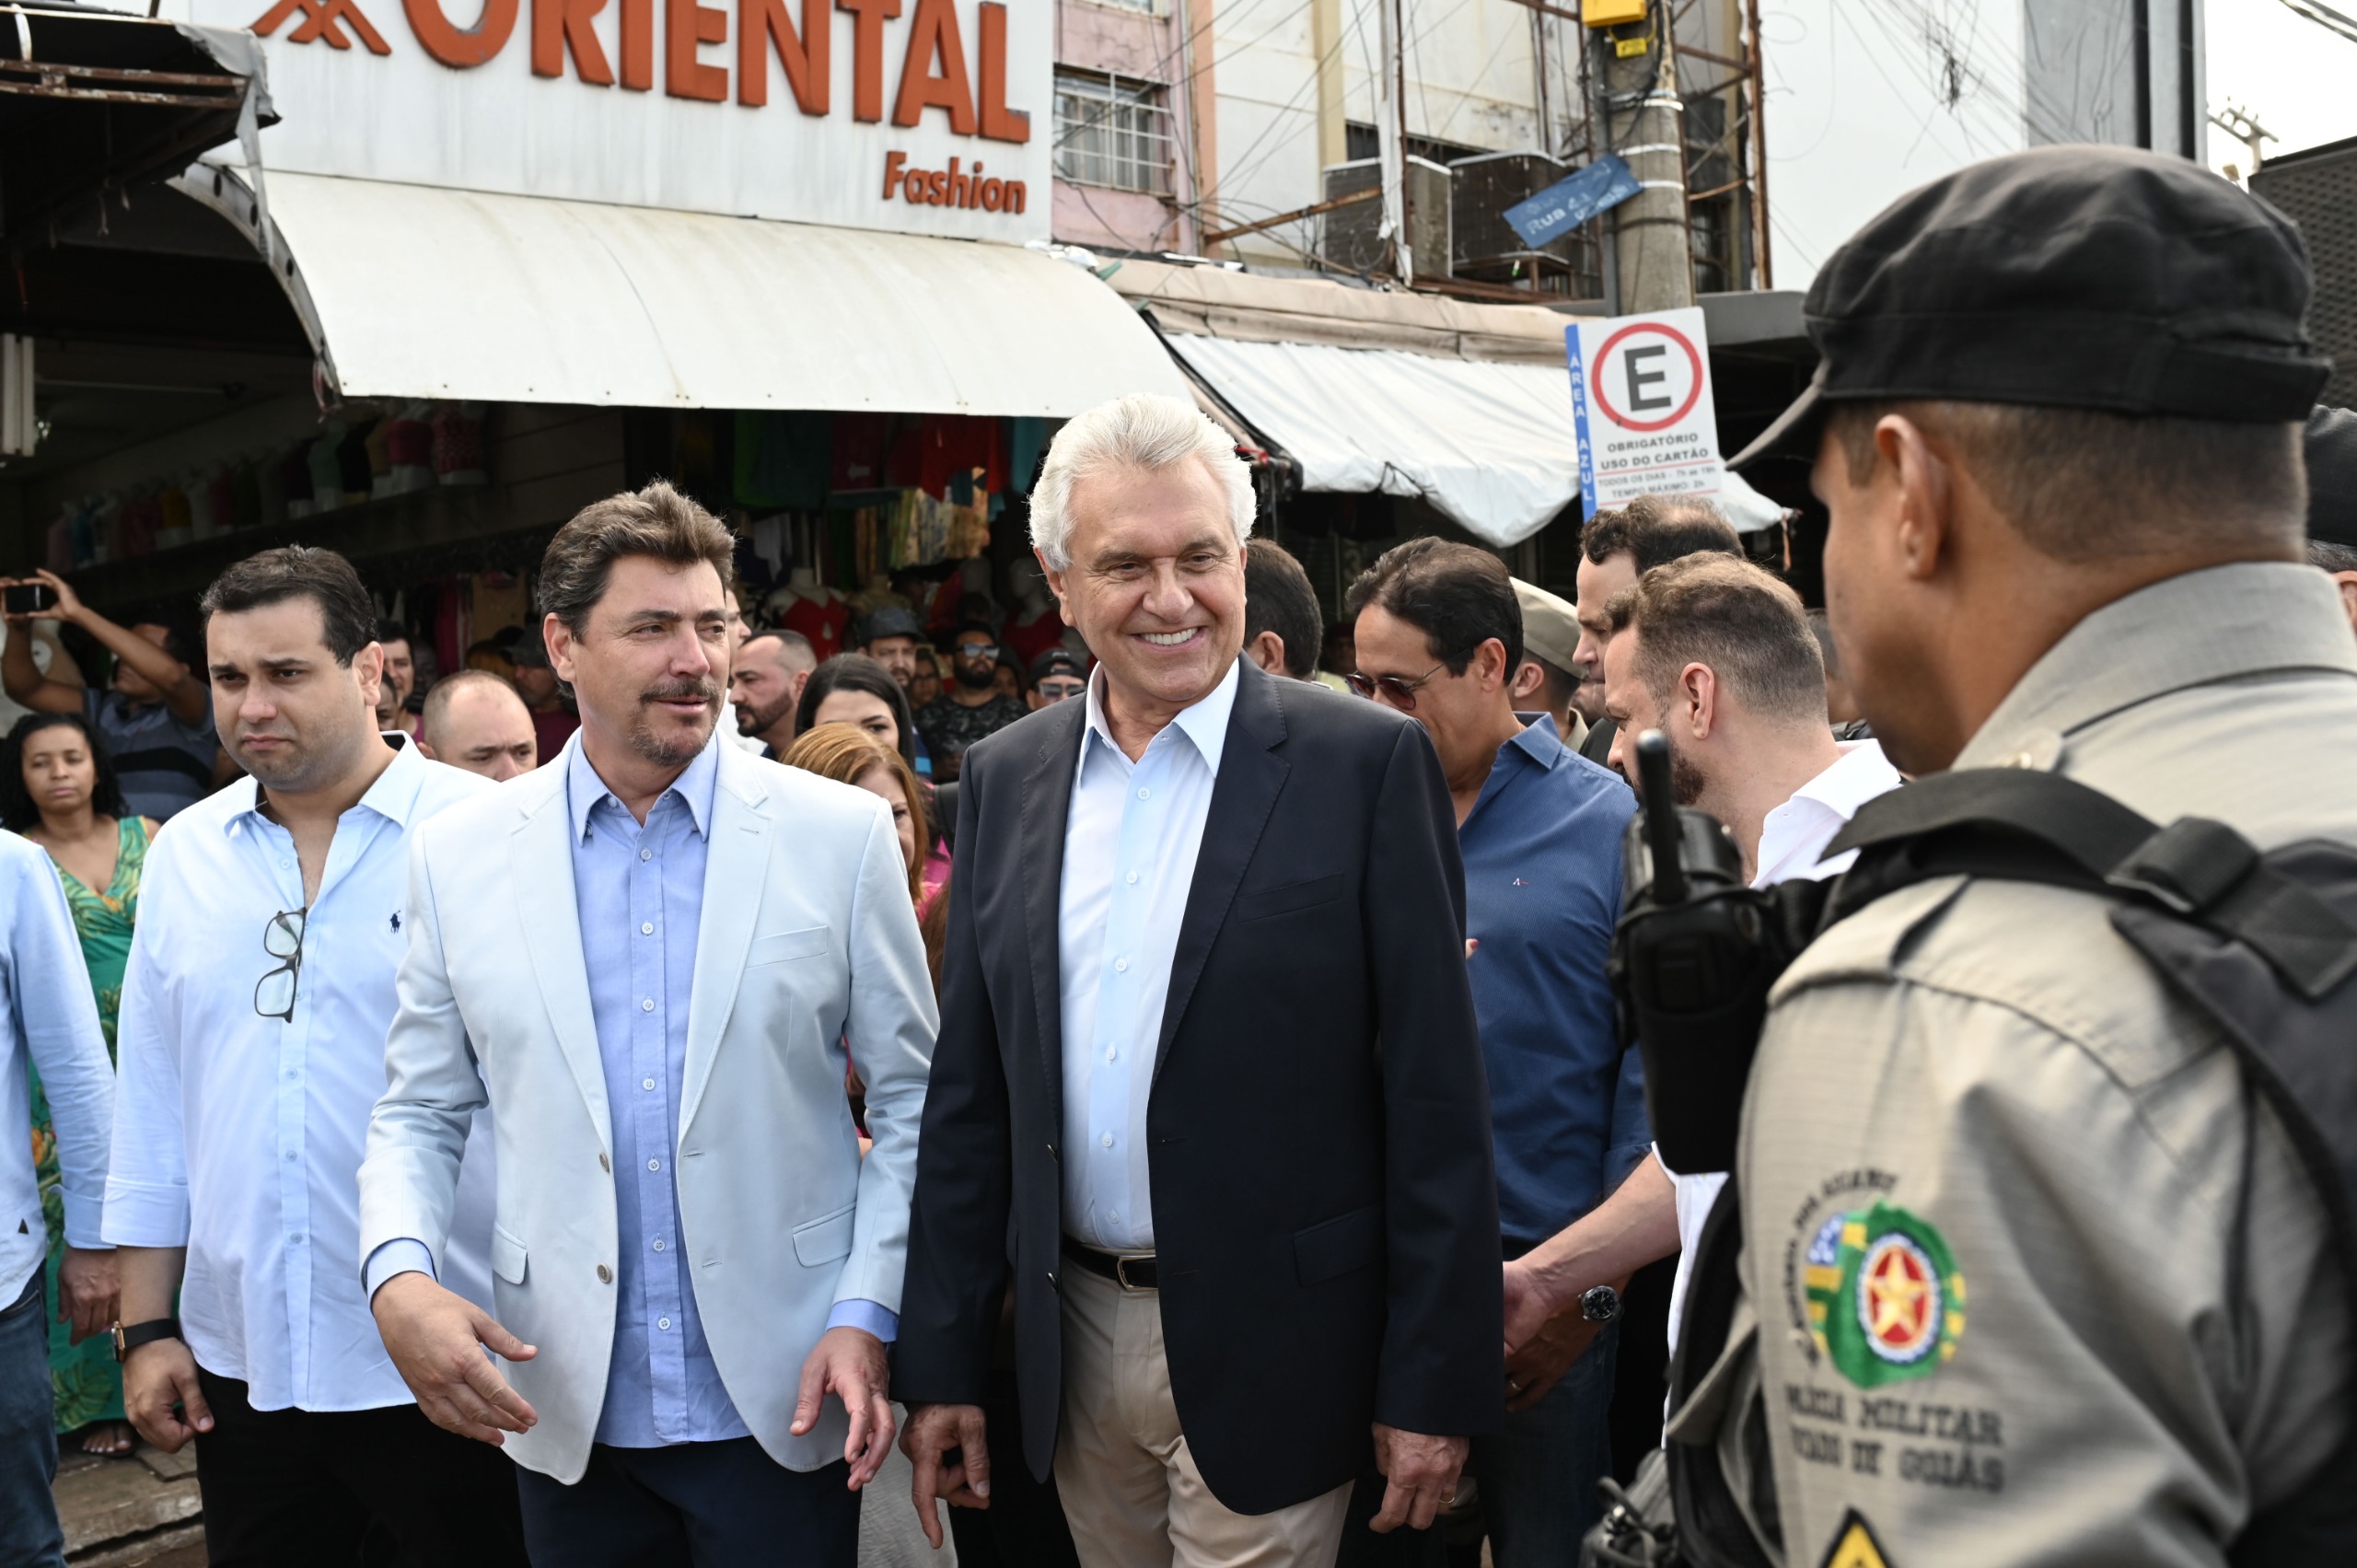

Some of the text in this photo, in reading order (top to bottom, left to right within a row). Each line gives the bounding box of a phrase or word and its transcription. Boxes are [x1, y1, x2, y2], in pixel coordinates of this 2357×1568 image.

[401, 0, 1030, 144] ORIENTAL
[883, 150, 1027, 215] Fashion
[1526, 207, 1566, 235] Rua
[1623, 343, 1672, 412] E
[1600, 447, 1709, 470] USO DO CARTÃO
[1607, 433, 1699, 453] OBRIGATÓRIO
[1578, 437, 1593, 502] AZUL
[1597, 475, 1629, 488] TODOS
[1631, 472, 1643, 483] OS
[1645, 470, 1666, 482] DIAS
[1612, 486, 1646, 499] TEMPO
[1859, 1397, 2003, 1446] MILITAR
